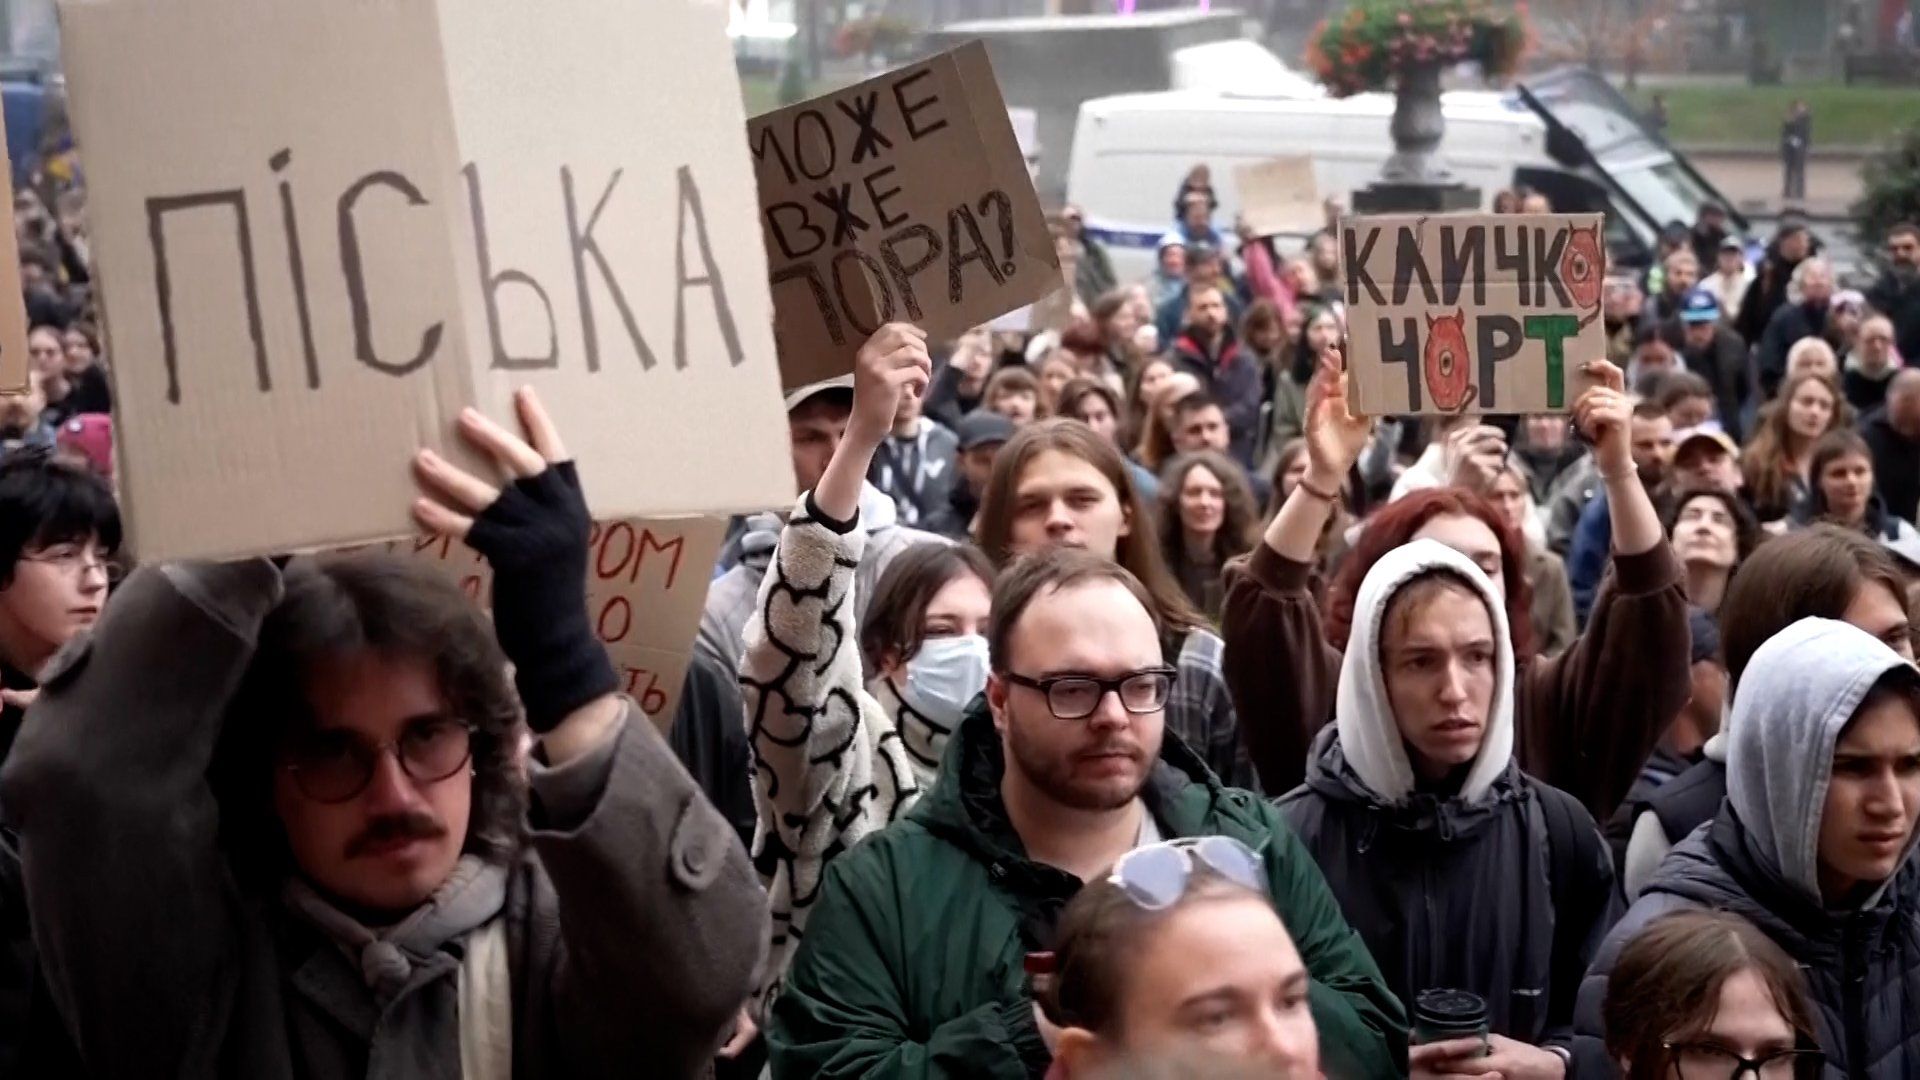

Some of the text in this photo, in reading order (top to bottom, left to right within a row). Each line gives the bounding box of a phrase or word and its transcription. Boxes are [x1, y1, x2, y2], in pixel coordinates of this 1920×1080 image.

[750, 69, 949, 185] МОЖЕ
[765, 165, 909, 260] ВЖЕ
[1344, 220, 1603, 310] КЛИЧКО
[771, 190, 1017, 346] ПОРА?
[1378, 307, 1580, 414] ЧОРТ
